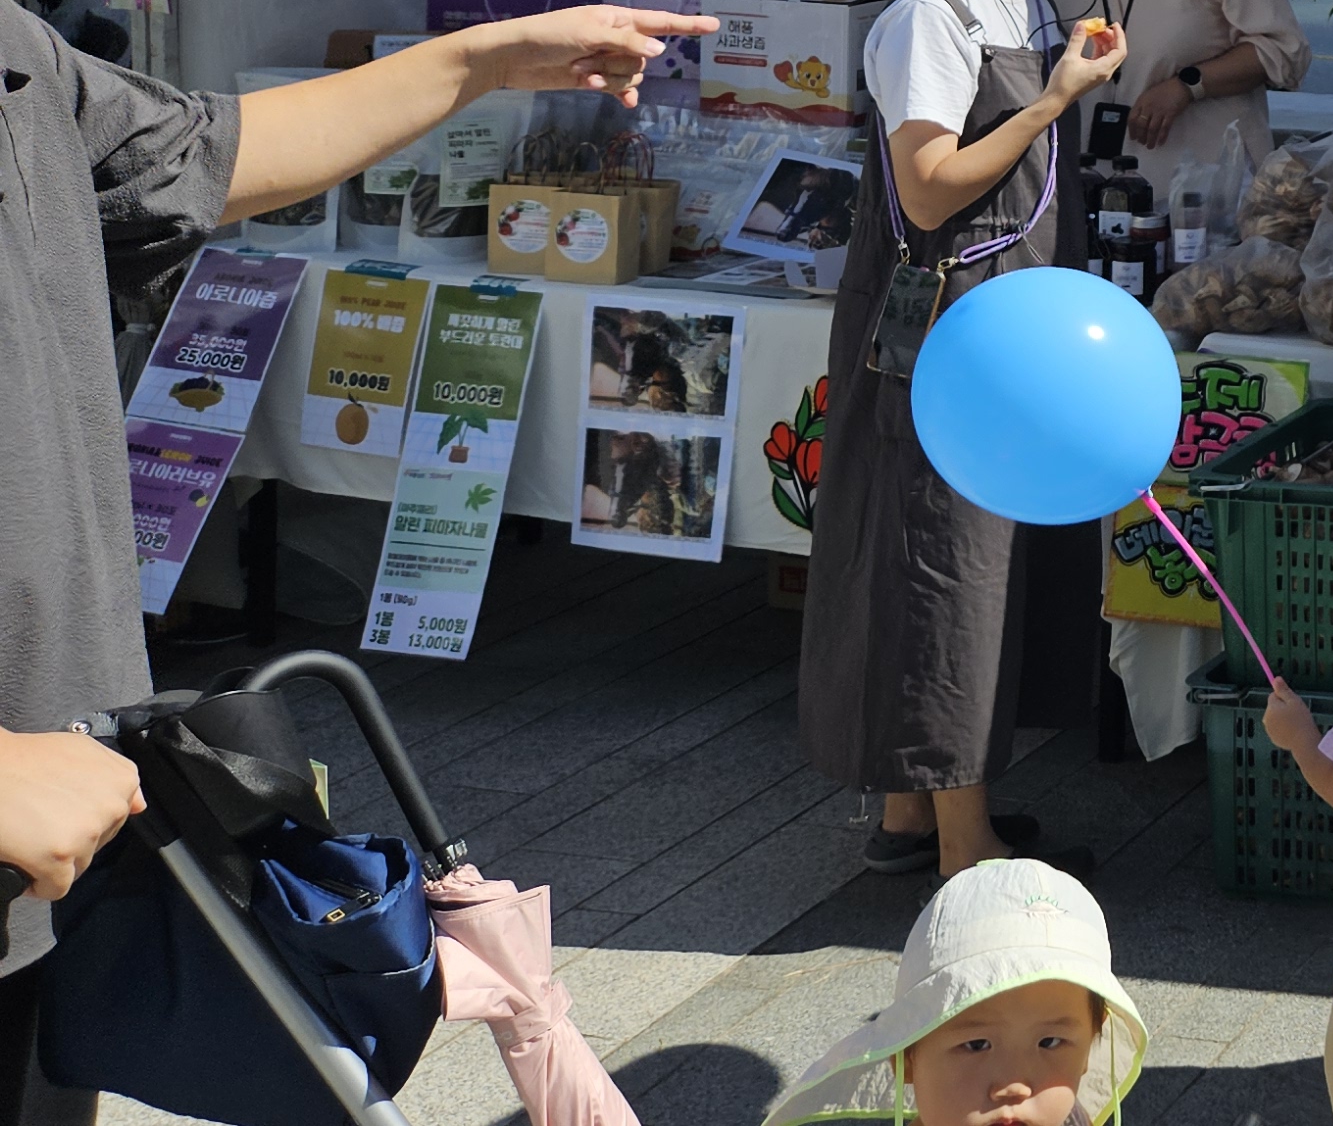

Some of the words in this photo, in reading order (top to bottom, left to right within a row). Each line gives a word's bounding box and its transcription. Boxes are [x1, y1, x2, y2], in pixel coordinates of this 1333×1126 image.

[716, 34, 767, 51] 사과생즙
[195, 282, 279, 310] 아로니아즙
[334, 309, 375, 330] 100%
[176, 348, 247, 371] 25,000원
[328, 368, 391, 392] 10,000원
[433, 381, 505, 407] 10,000원
[374, 610, 395, 628] 1봉
[417, 615, 469, 635] 5,000원
[369, 628, 392, 646] 3봉
